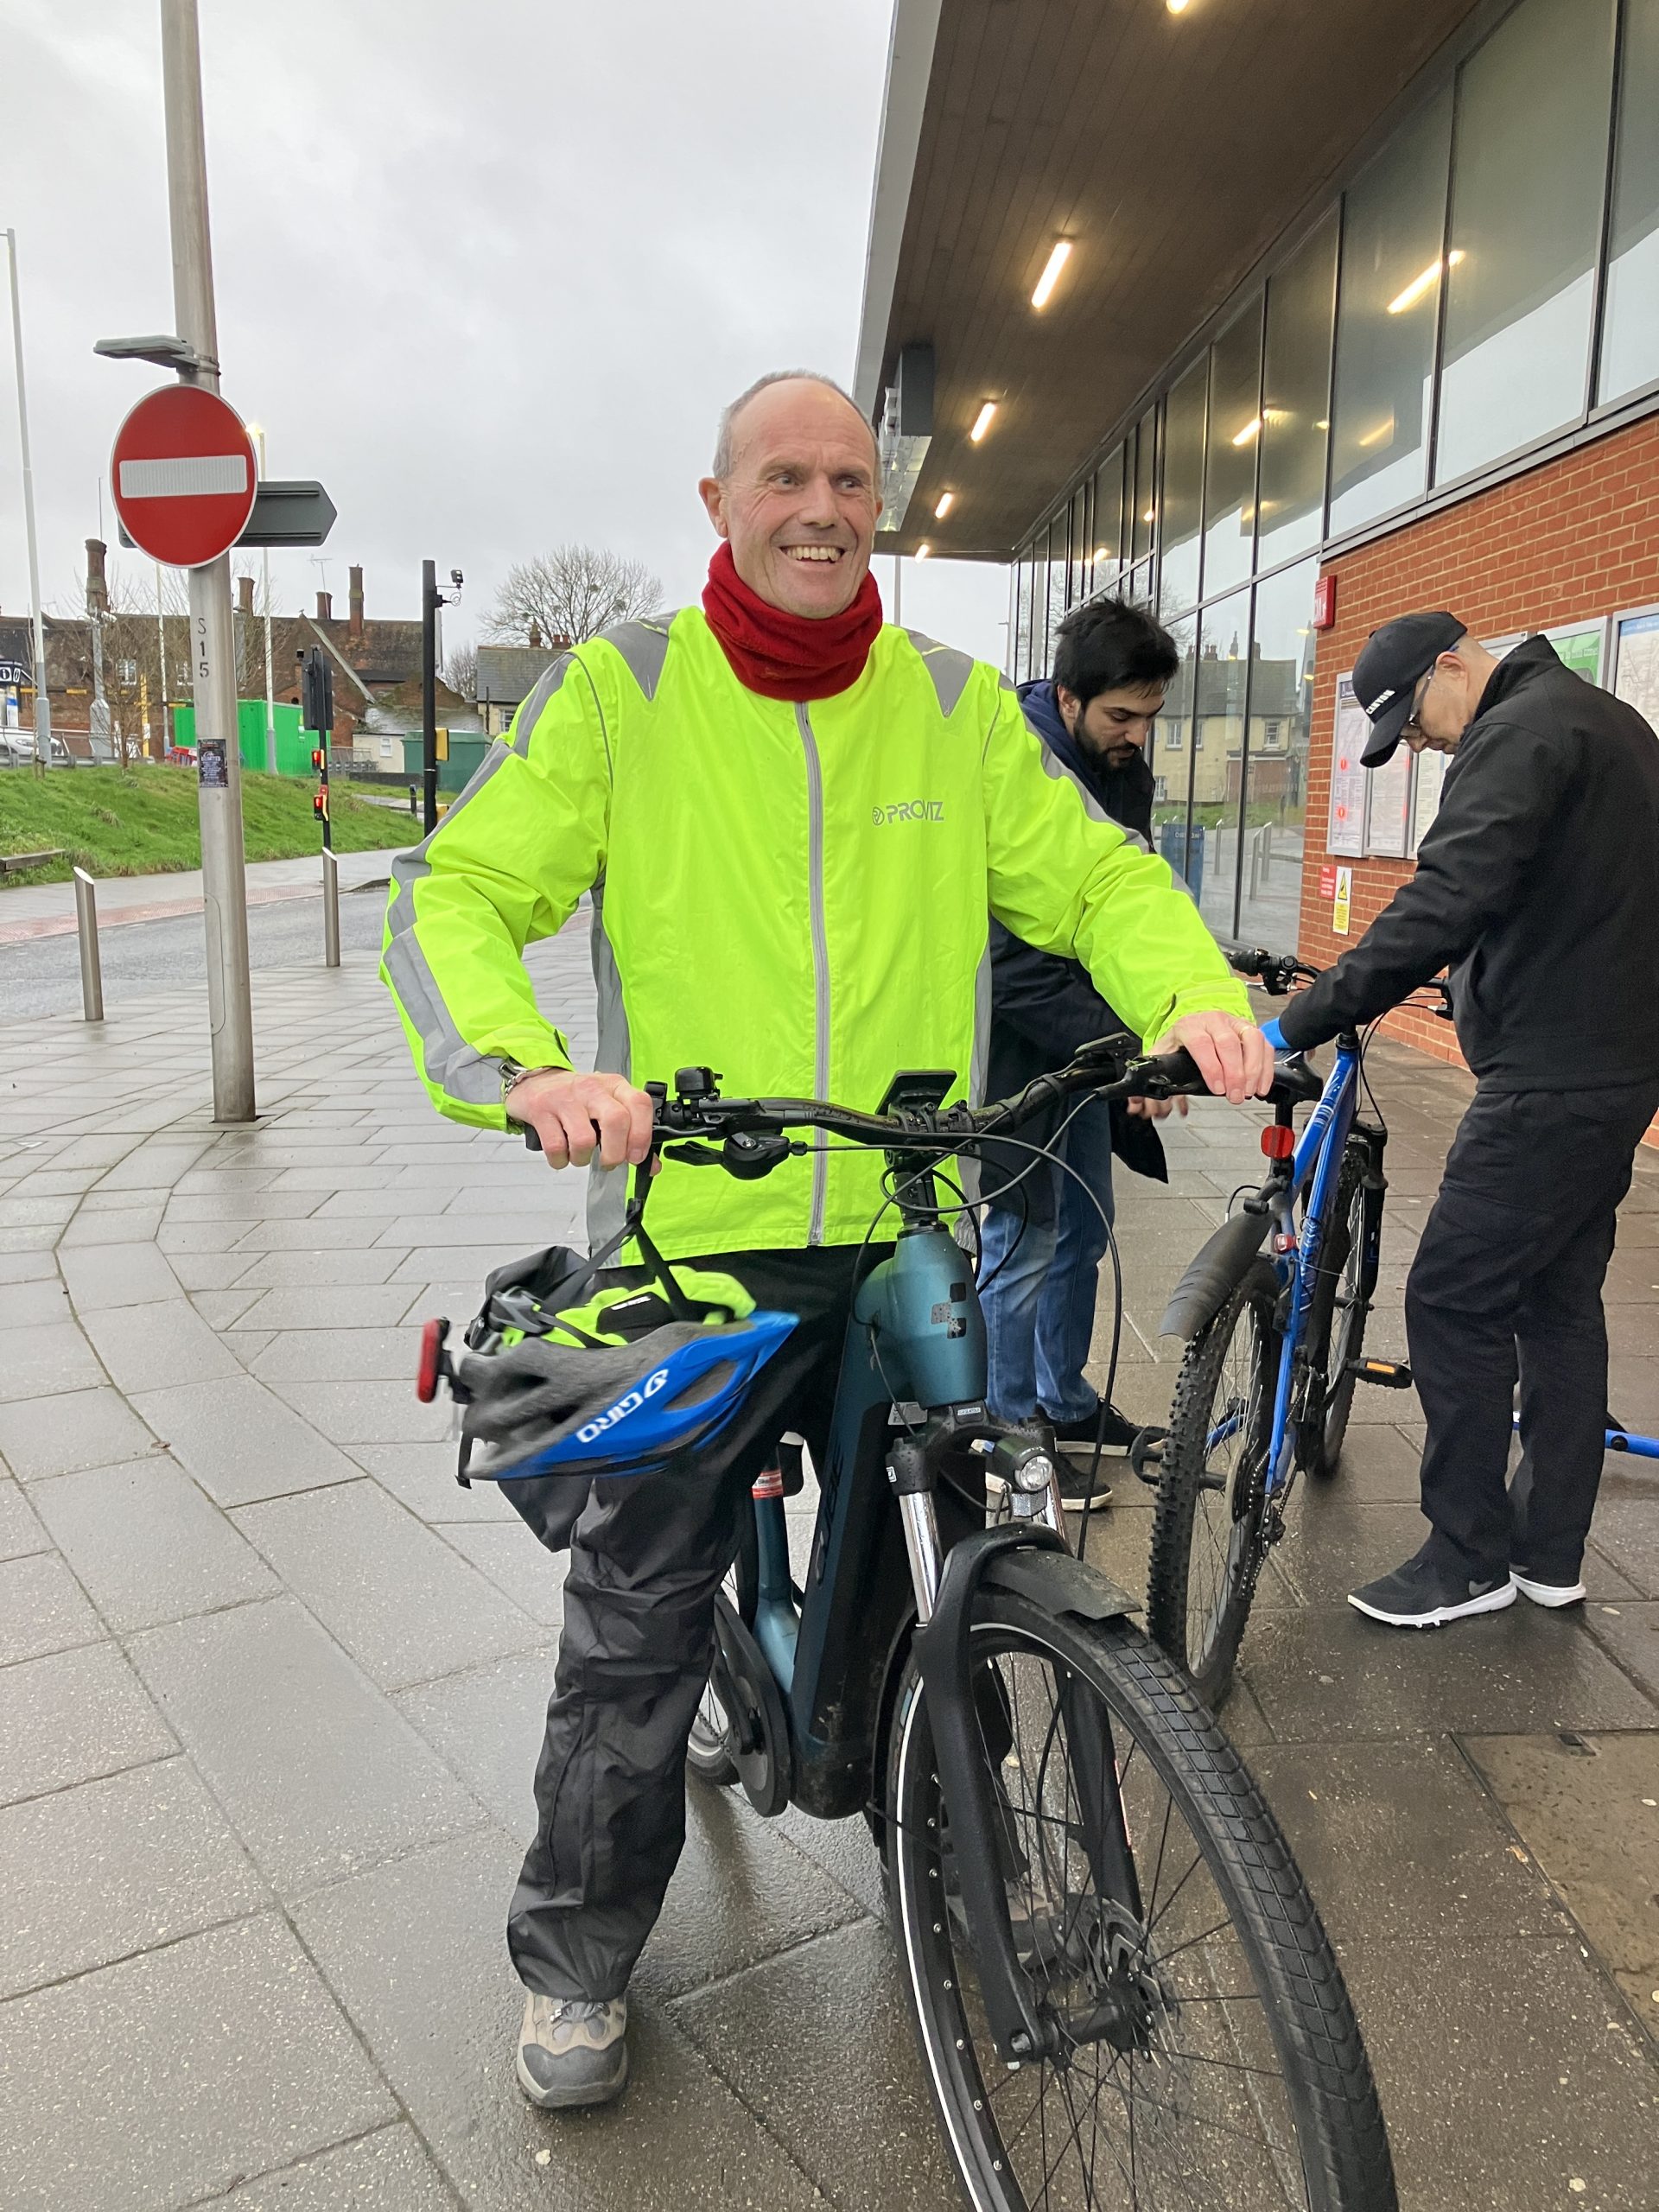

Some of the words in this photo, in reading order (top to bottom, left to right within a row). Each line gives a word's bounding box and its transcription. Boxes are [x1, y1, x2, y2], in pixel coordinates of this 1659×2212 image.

[1365, 690, 1395, 715] CANYON
[886, 799, 944, 824] PROVIZ
[575, 1392, 644, 1443] GIRO
